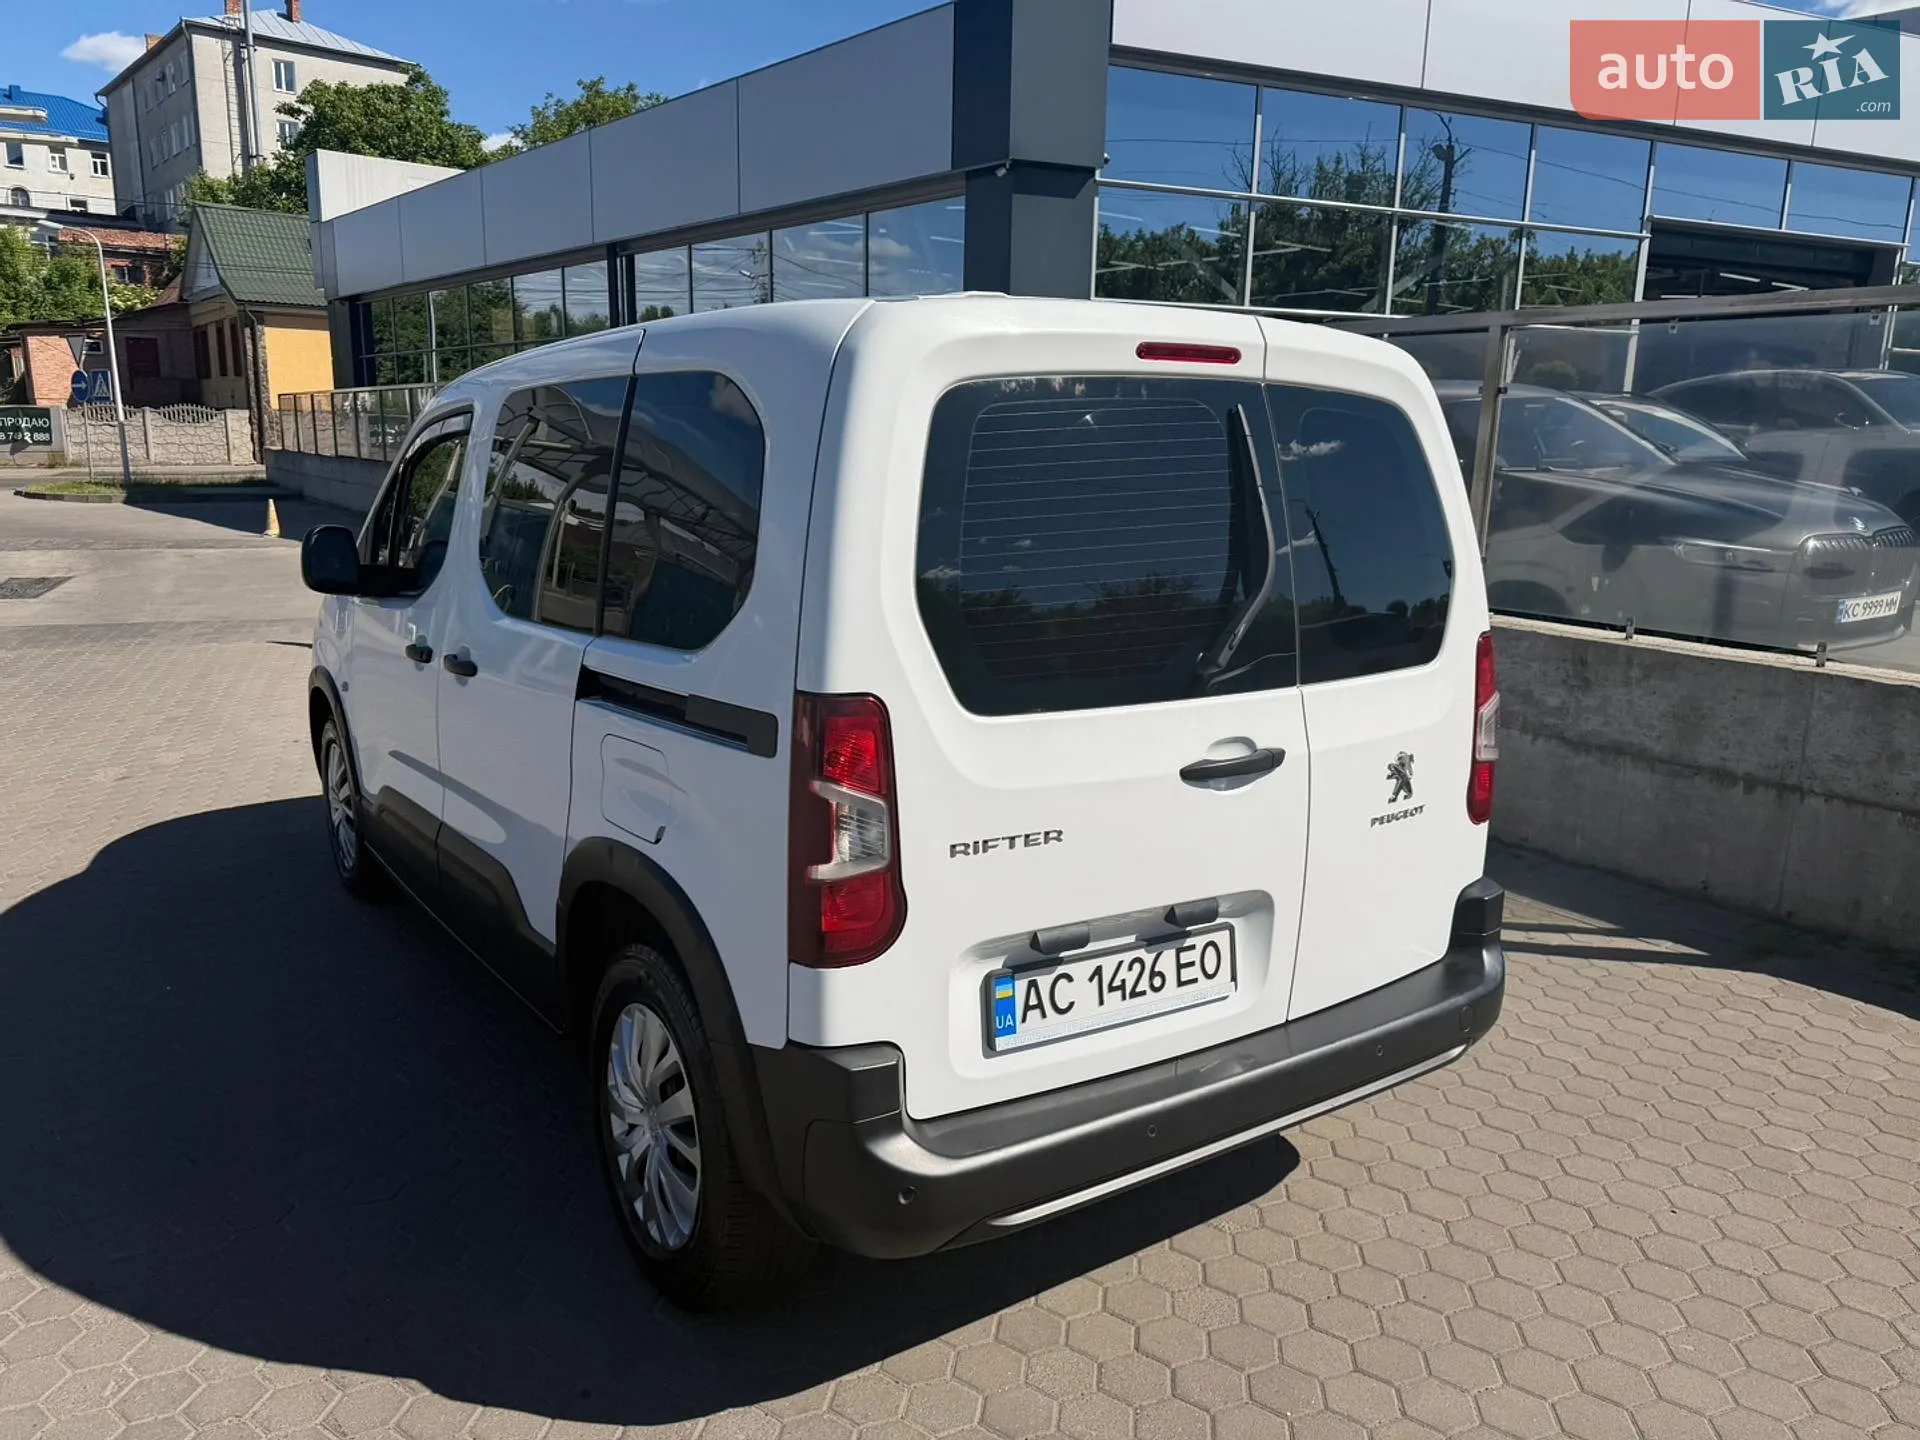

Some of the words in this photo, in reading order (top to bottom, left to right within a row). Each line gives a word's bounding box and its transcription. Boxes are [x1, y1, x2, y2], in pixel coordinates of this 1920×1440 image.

[1370, 804, 1426, 828] PEUGEOT
[949, 829, 1063, 858] RIFTER
[1021, 972, 1075, 1023] AC
[1088, 951, 1166, 1006] 1426
[1176, 940, 1221, 988] EO
[996, 1015, 1014, 1029] UA
